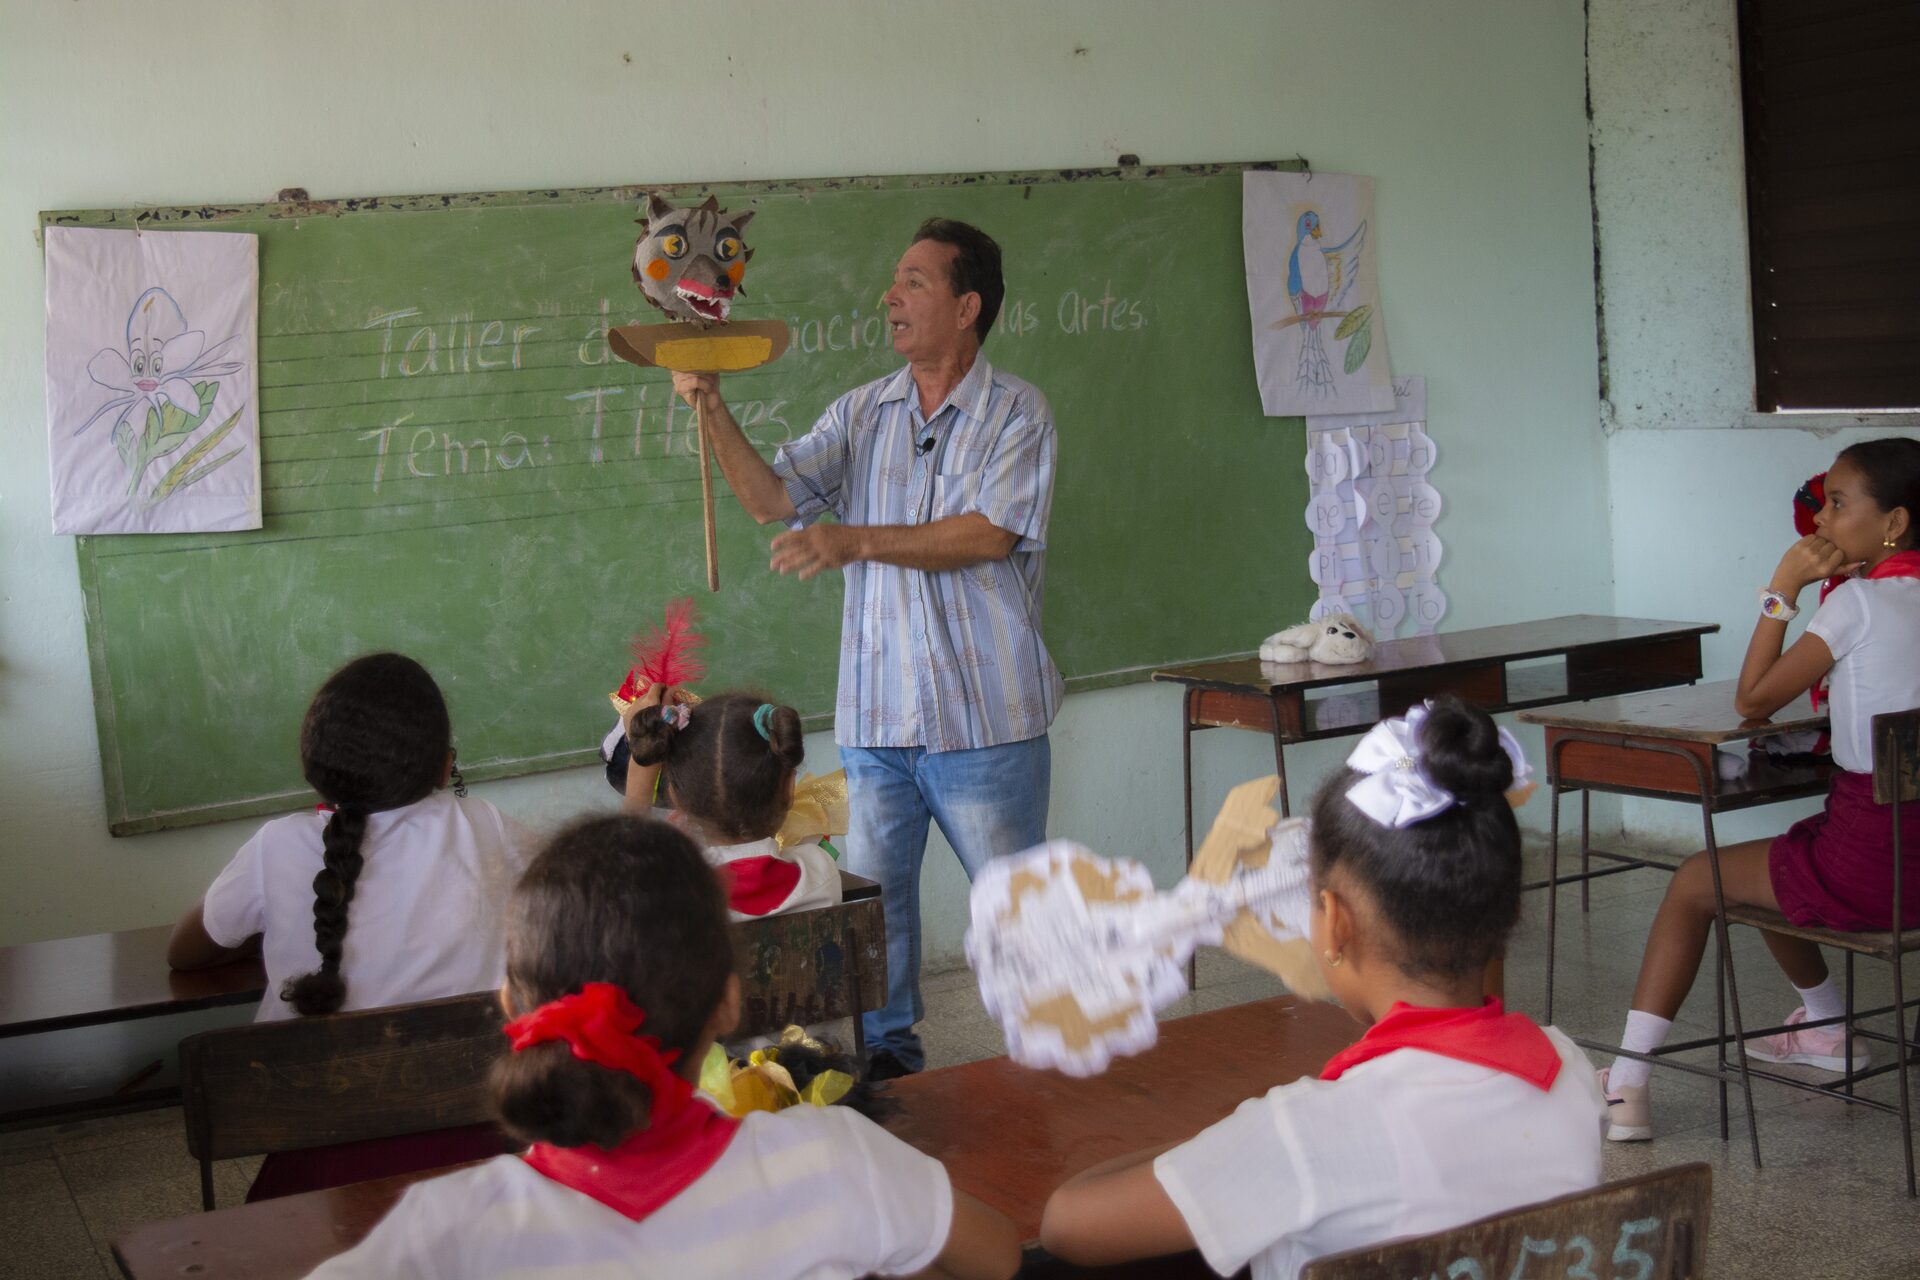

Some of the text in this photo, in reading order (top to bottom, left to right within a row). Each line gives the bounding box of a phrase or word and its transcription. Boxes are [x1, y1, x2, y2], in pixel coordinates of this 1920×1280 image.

[364, 306, 541, 379] Taller
[1316, 504, 1339, 530] pe
[1319, 551, 1337, 580] pi
